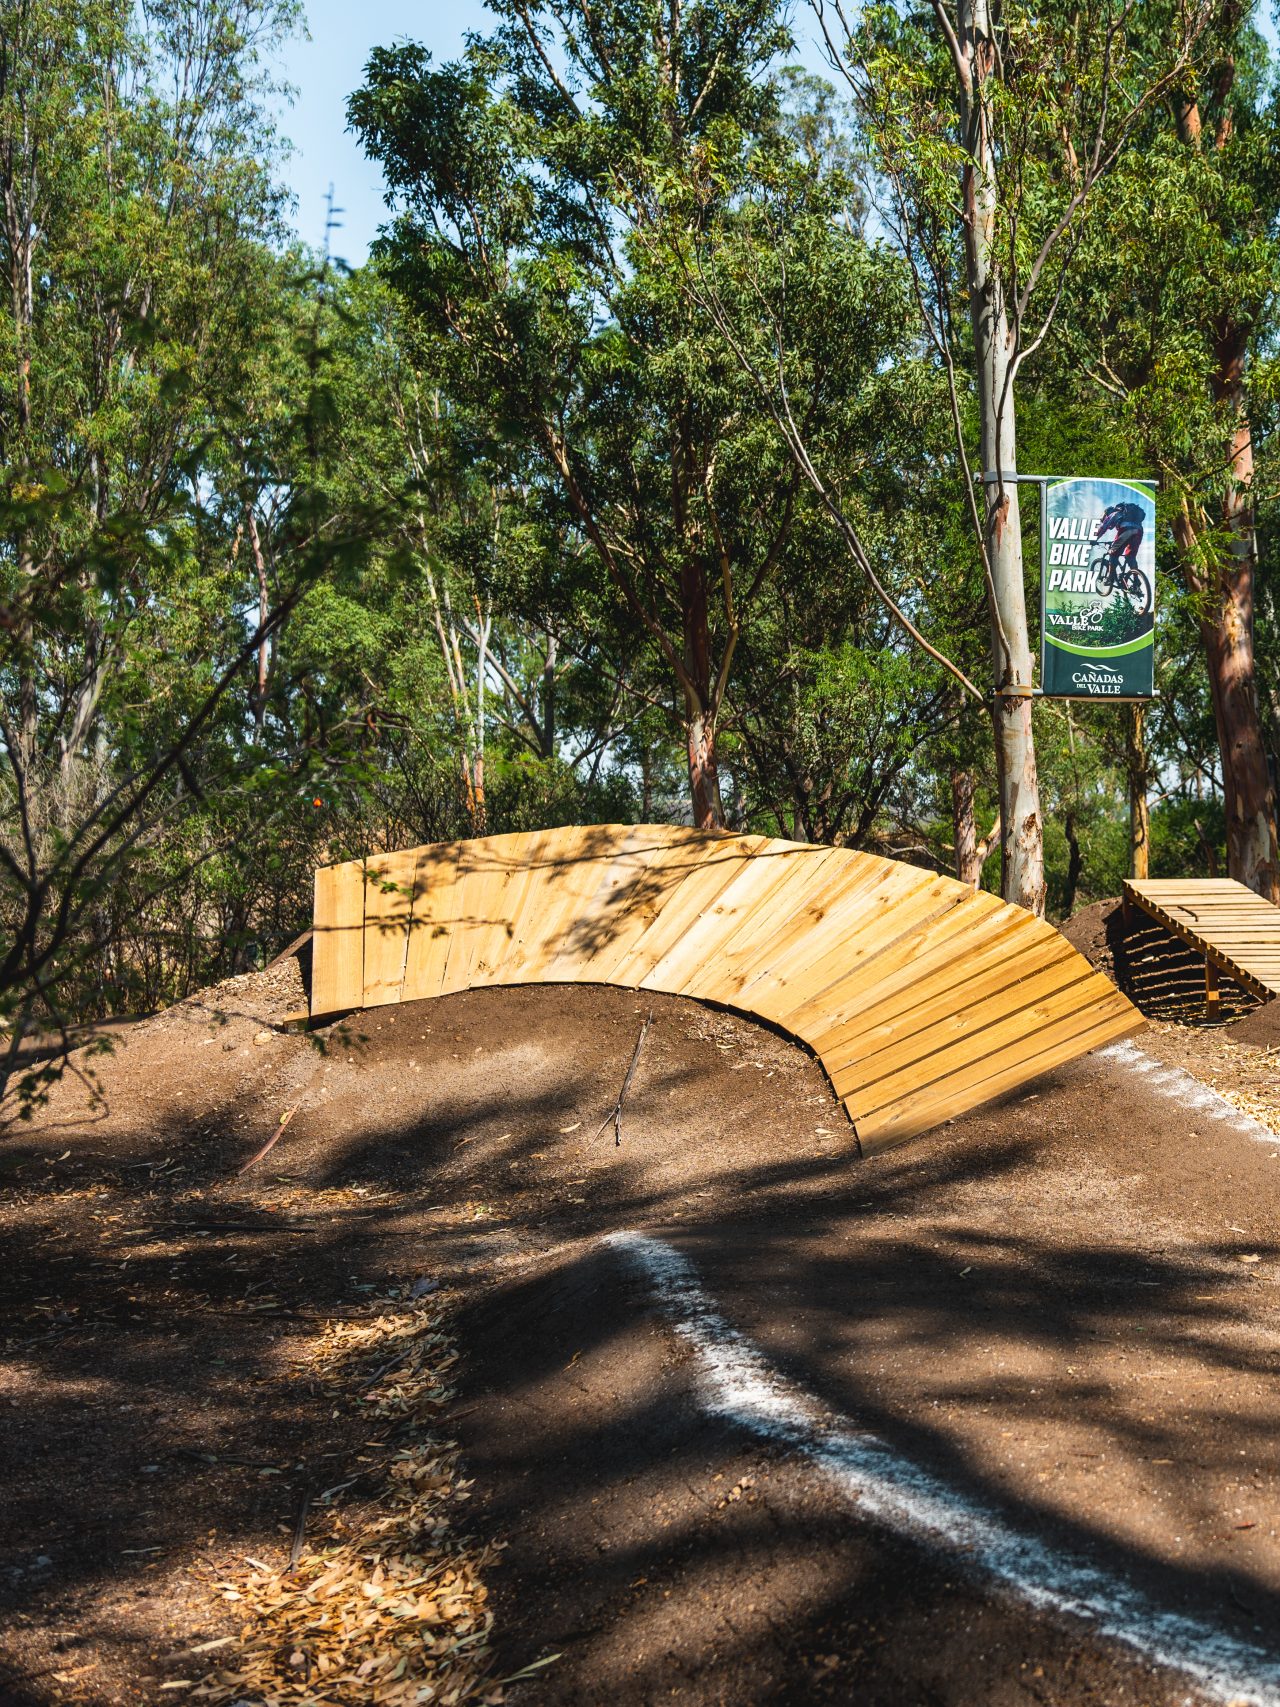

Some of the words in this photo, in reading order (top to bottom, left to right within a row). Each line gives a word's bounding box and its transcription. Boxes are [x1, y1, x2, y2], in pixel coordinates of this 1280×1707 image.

[1049, 516, 1100, 541] VALLE
[1049, 543, 1090, 566] BIKE
[1048, 569, 1099, 593] PARK
[1048, 614, 1089, 626] VALLE
[1072, 671, 1124, 684] CAÑADAS
[1088, 684, 1121, 694] VALLE
